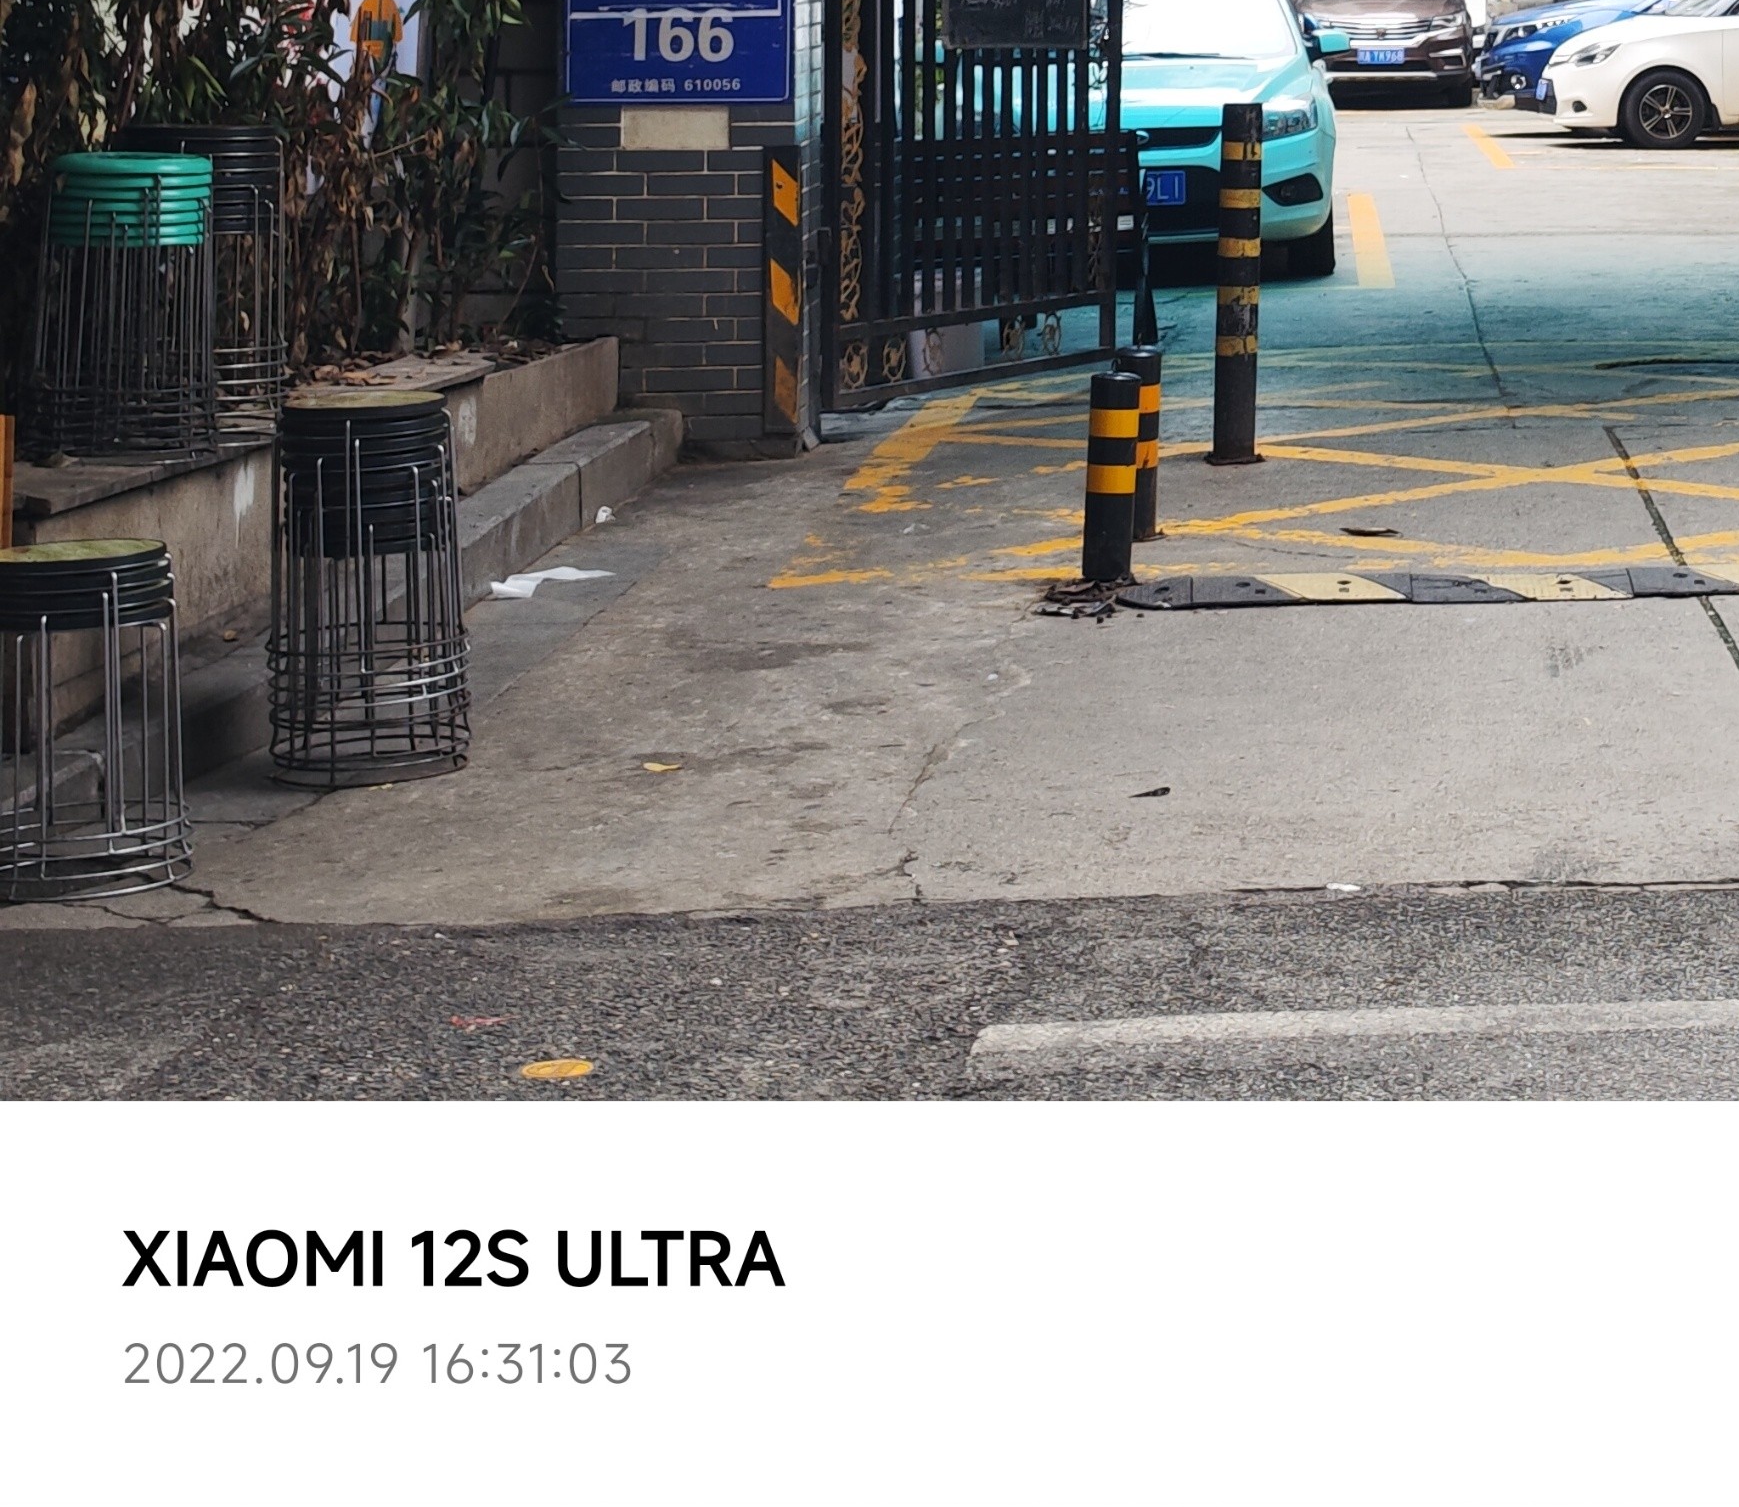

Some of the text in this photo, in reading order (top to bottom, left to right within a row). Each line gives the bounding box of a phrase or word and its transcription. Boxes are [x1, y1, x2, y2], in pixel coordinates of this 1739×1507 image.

[623, 7, 735, 63] 166
[611, 78, 741, 93] 邮政编码 610056
